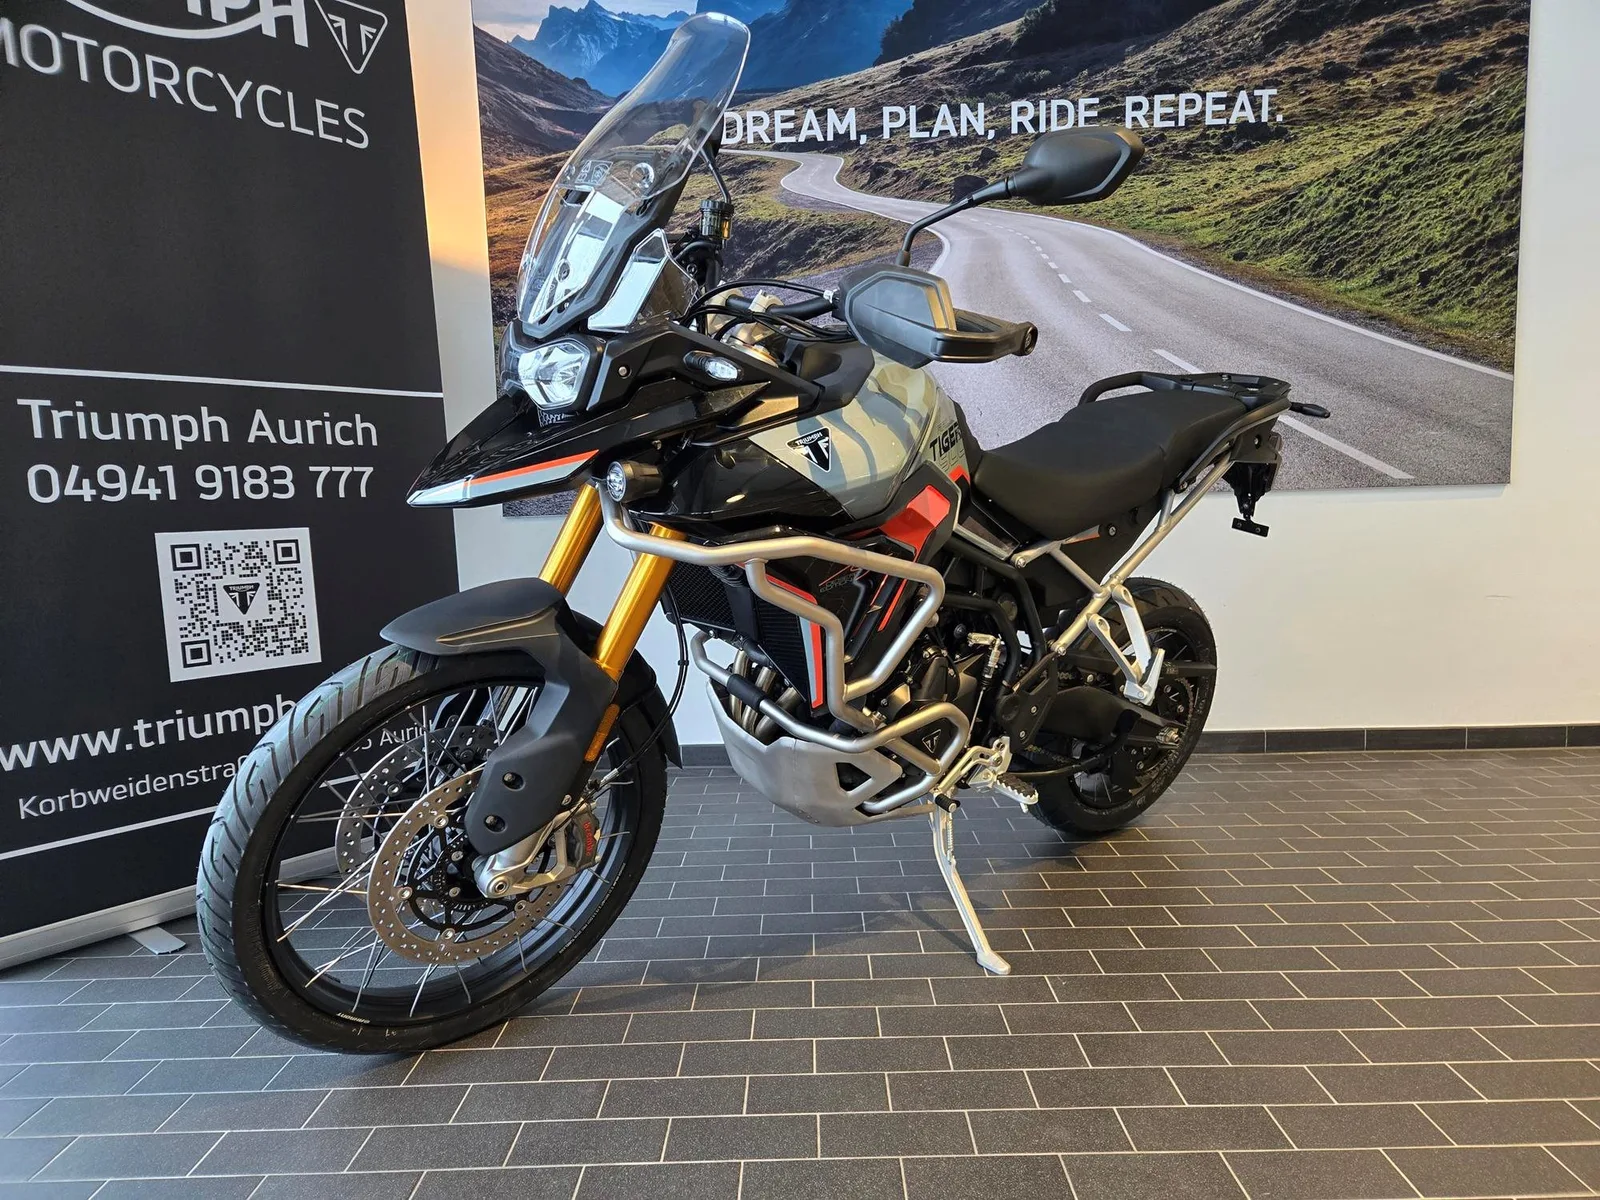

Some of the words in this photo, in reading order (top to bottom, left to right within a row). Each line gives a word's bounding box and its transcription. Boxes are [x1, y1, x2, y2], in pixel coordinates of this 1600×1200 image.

[721, 108, 868, 146] DREAM,
[882, 102, 995, 140] PLAN,
[1011, 97, 1100, 134] RIDE
[1125, 88, 1283, 129] REPEAT.
[16, 398, 229, 450] Triumph
[247, 408, 378, 447] Aurich
[795, 431, 823, 446] TRIUMPH
[27, 463, 177, 504] 04941
[195, 464, 295, 500] 9183
[308, 466, 374, 498] 777
